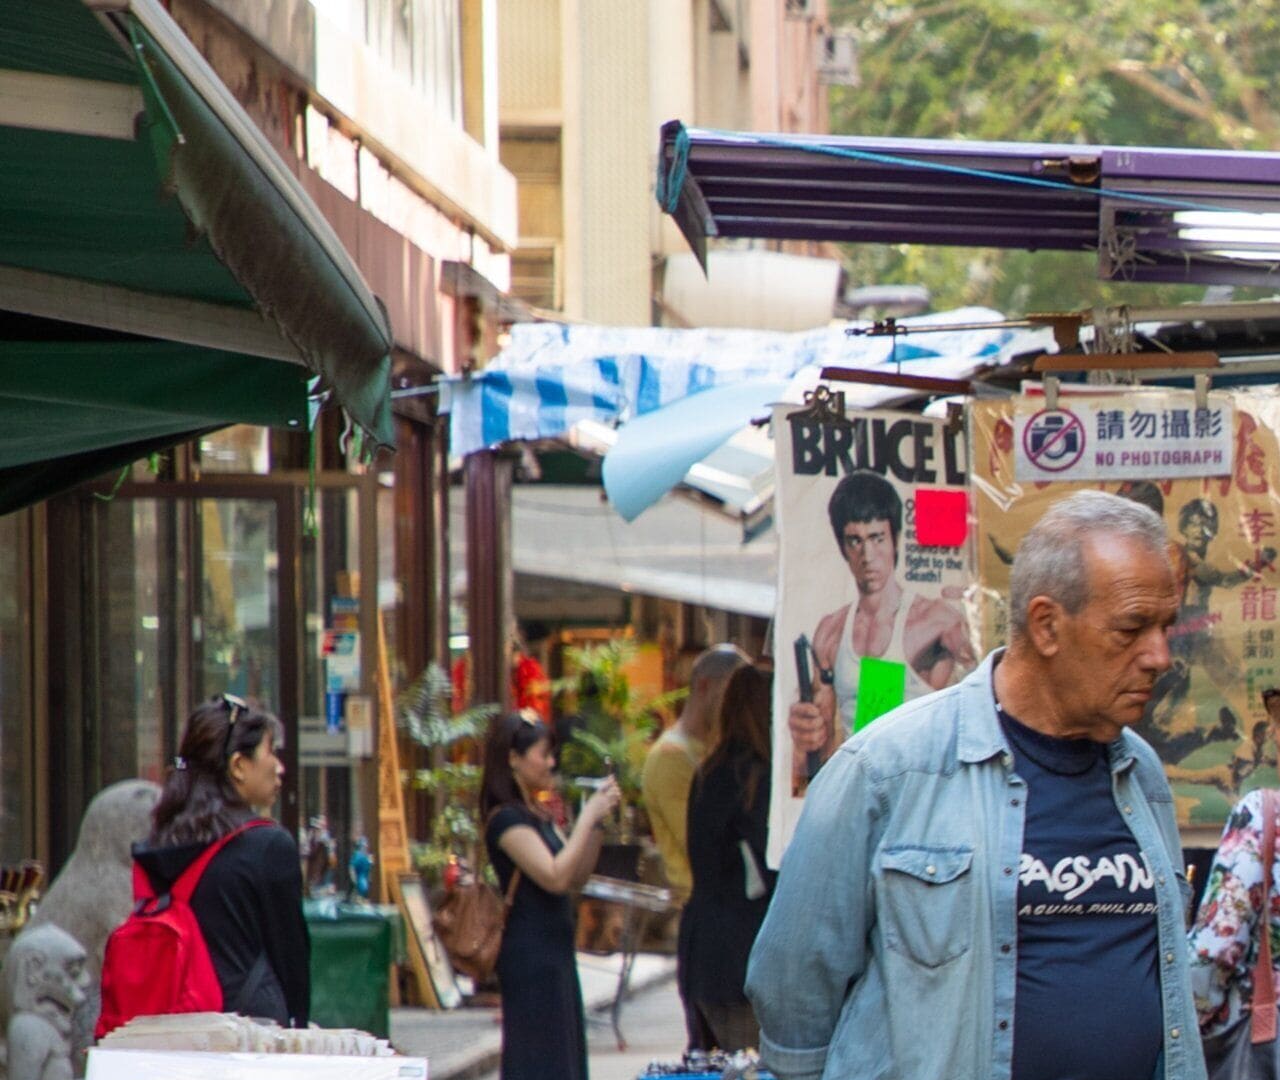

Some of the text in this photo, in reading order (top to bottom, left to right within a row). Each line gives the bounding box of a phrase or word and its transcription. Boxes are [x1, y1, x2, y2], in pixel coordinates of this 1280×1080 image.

[1096, 409, 1222, 440] 請勿攝影
[791, 418, 937, 484] BRUCE
[1095, 449, 1222, 467] NO PHOTOGRAPH
[905, 556, 963, 570] fight to the
[905, 571, 942, 583] death!
[1018, 903, 1159, 916] AGUNA, PHILIPPI
